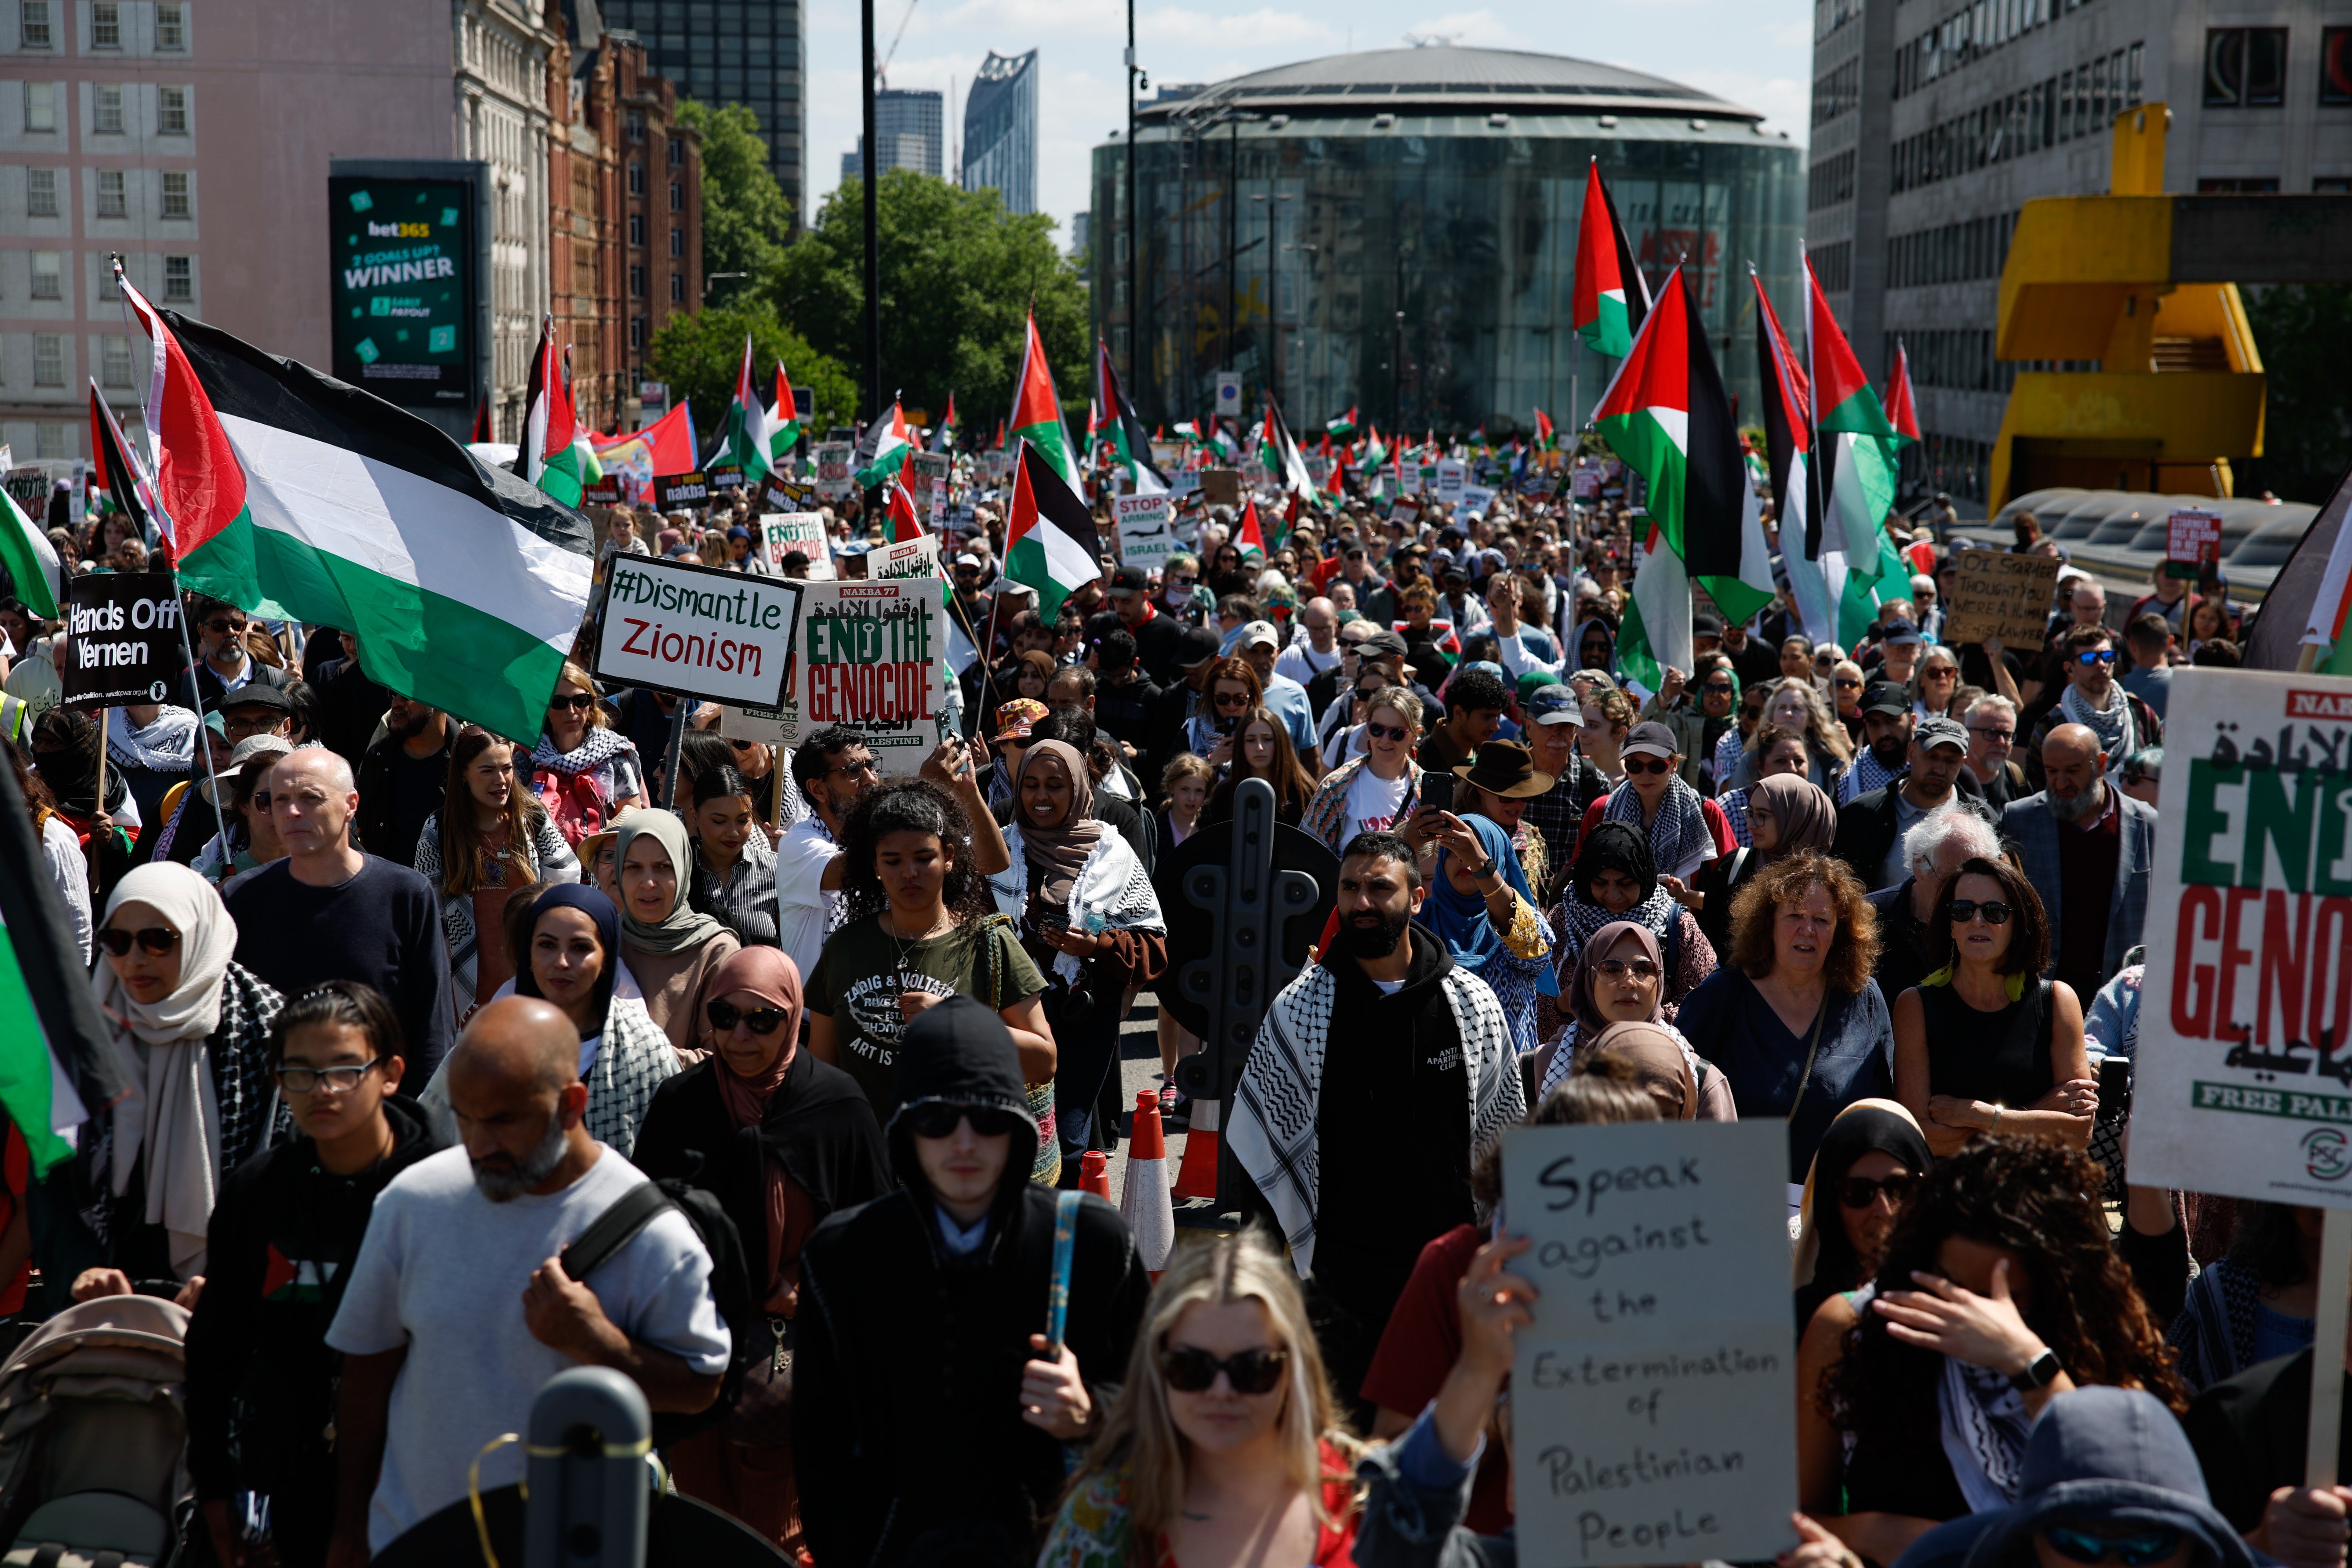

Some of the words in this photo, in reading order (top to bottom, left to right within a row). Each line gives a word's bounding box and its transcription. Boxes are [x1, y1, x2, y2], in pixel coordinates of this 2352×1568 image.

[368, 220, 430, 238] bet365
[353, 254, 361, 267] 2
[364, 248, 410, 265] GOALS
[412, 244, 441, 259] UP?
[345, 257, 455, 289] WINNER
[682, 472, 705, 484] MORE
[714, 473, 743, 485] nakba
[588, 491, 618, 501] PALESTINE
[667, 484, 706, 501] nakba
[767, 486, 798, 513] nakba
[785, 485, 803, 502] MORE
[1120, 498, 1162, 513] STOP
[1121, 512, 1165, 524] ARMING
[768, 526, 799, 544] END
[891, 548, 910, 559] NAKBA
[1125, 542, 1169, 556] ISRAEL
[613, 569, 781, 630] #Dismantle
[1959, 576, 2018, 597] THOUGHT
[2020, 582, 2046, 602] YOU
[70, 600, 124, 635] Hands
[132, 598, 178, 630] Off
[814, 599, 869, 624] الإبادة
[876, 596, 926, 626] أوقفوا
[1955, 597, 1994, 615] WERE
[1998, 600, 2007, 616] A
[807, 615, 882, 665] END
[890, 613, 933, 663] THE
[1996, 621, 2045, 641] LAWYER
[78, 637, 149, 669] Yemen
[621, 618, 761, 677] Zionism
[83, 692, 104, 700] Coalition.
[105, 689, 148, 697] www.stopwar.org.uk
[808, 661, 934, 722] GENOCIDE
[746, 708, 773, 719] FREE
[844, 975, 882, 1004] ZADIG
[886, 975, 894, 987] &
[900, 972, 955, 1000] VOLTAIR
[849, 1037, 877, 1060] ART
[879, 1049, 892, 1065] IS
[1439, 1047, 1457, 1058] ANTI
[1439, 1060, 1456, 1071] CLUB
[2201, 1085, 2283, 1113] FREE
[2309, 1143, 2345, 1167] PSC
[1537, 1155, 1704, 1217] Speak
[1538, 1215, 1711, 1280] against
[1590, 1288, 1658, 1323] the
[1532, 1347, 1779, 1389] Extermination
[1627, 1388, 1662, 1425] of
[1537, 1444, 1744, 1498] Palestinian
[1578, 1508, 1721, 1560] People
